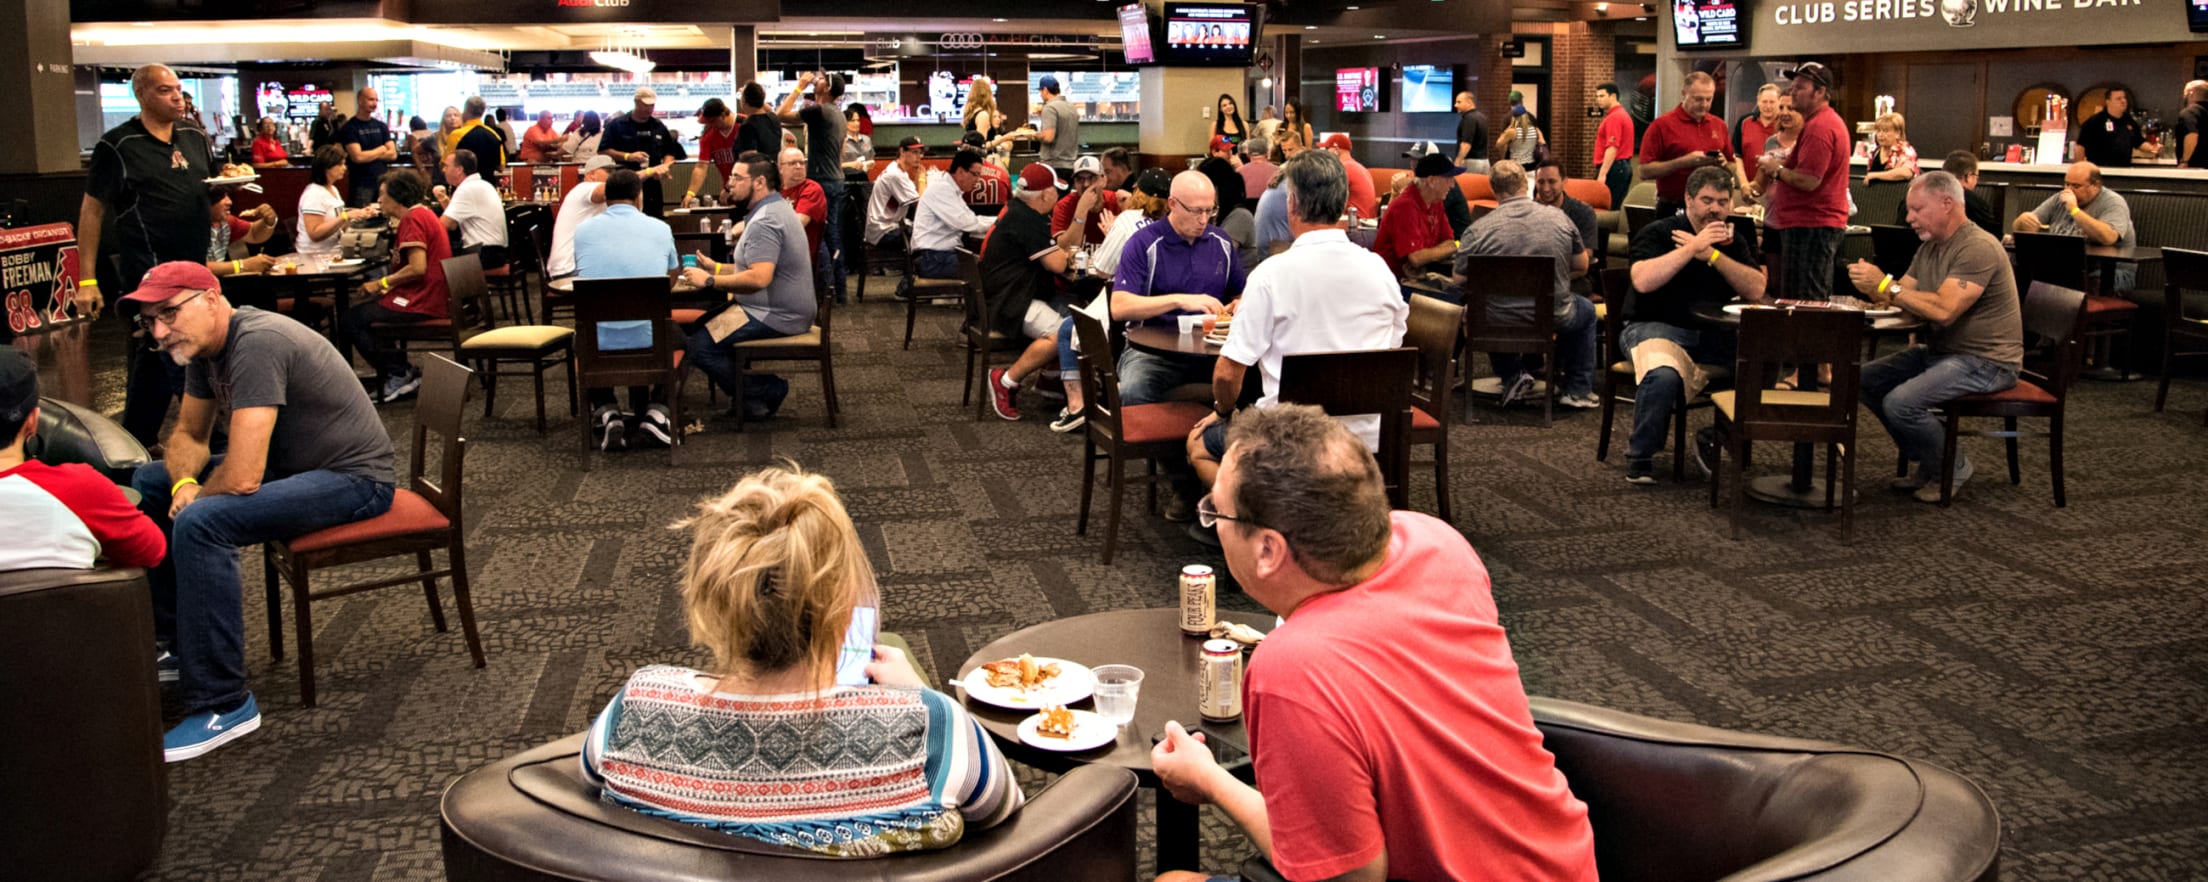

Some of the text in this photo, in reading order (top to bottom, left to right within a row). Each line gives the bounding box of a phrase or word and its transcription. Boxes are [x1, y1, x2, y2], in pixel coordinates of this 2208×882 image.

[1775, 3, 1836, 25] CLUB
[1844, 0, 1936, 21] SERIES
[971, 178, 998, 205] 21
[1, 252, 36, 267] BOBBY
[2, 261, 53, 290] FREEMAN
[5, 289, 42, 333] 88
